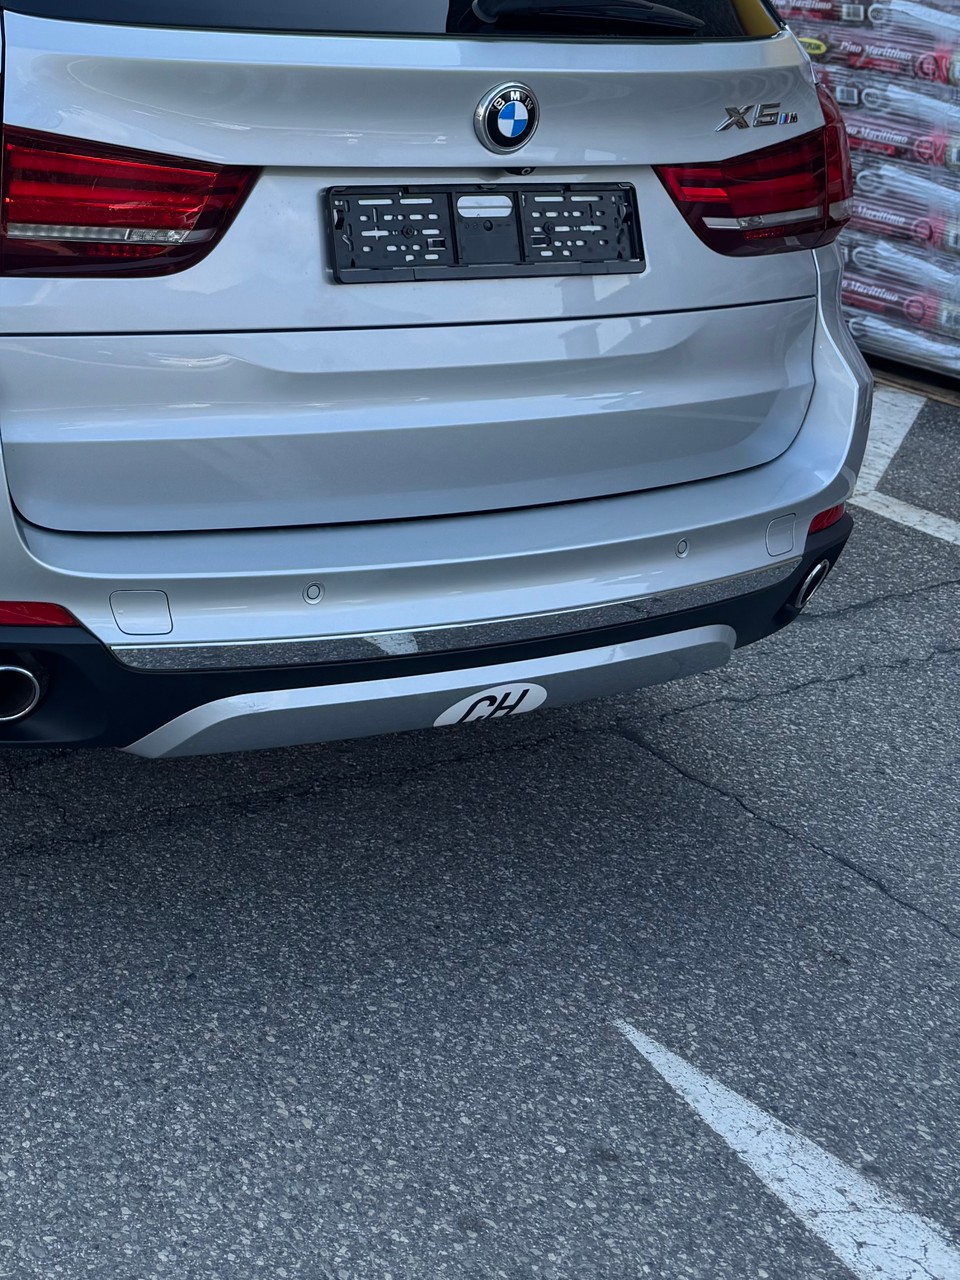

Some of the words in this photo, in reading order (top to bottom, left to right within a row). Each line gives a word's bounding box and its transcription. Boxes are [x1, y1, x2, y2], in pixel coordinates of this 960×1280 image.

[840, 41, 862, 53] Pino
[864, 44, 913, 60] Marittimo
[493, 91, 534, 110] BMW
[715, 102, 781, 132] X5
[861, 126, 909, 144] Marittimo
[456, 688, 531, 724] CH
